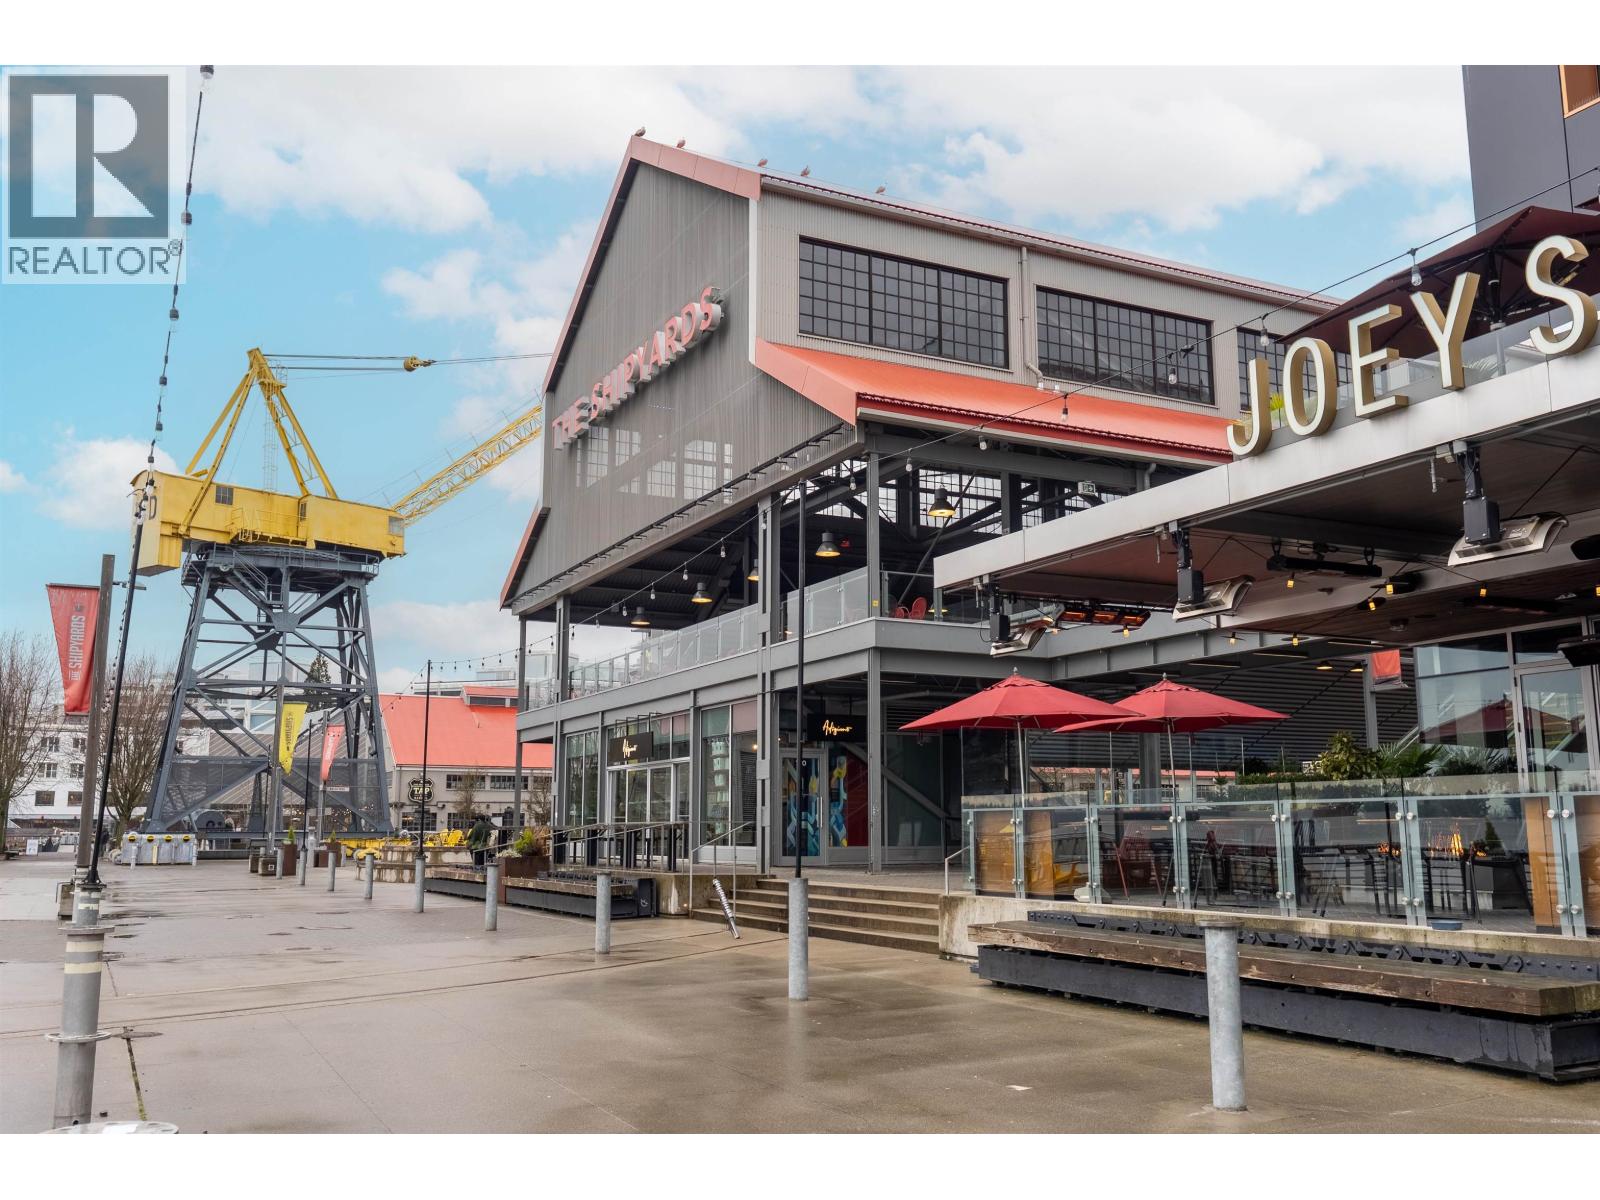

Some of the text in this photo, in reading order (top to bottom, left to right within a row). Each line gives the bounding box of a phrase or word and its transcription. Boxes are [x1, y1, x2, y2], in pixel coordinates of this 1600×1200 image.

[552, 286, 722, 451] THE SHIPYARDS
[69, 615, 86, 669] SHIPYARDS
[413, 787, 430, 795] TAP
